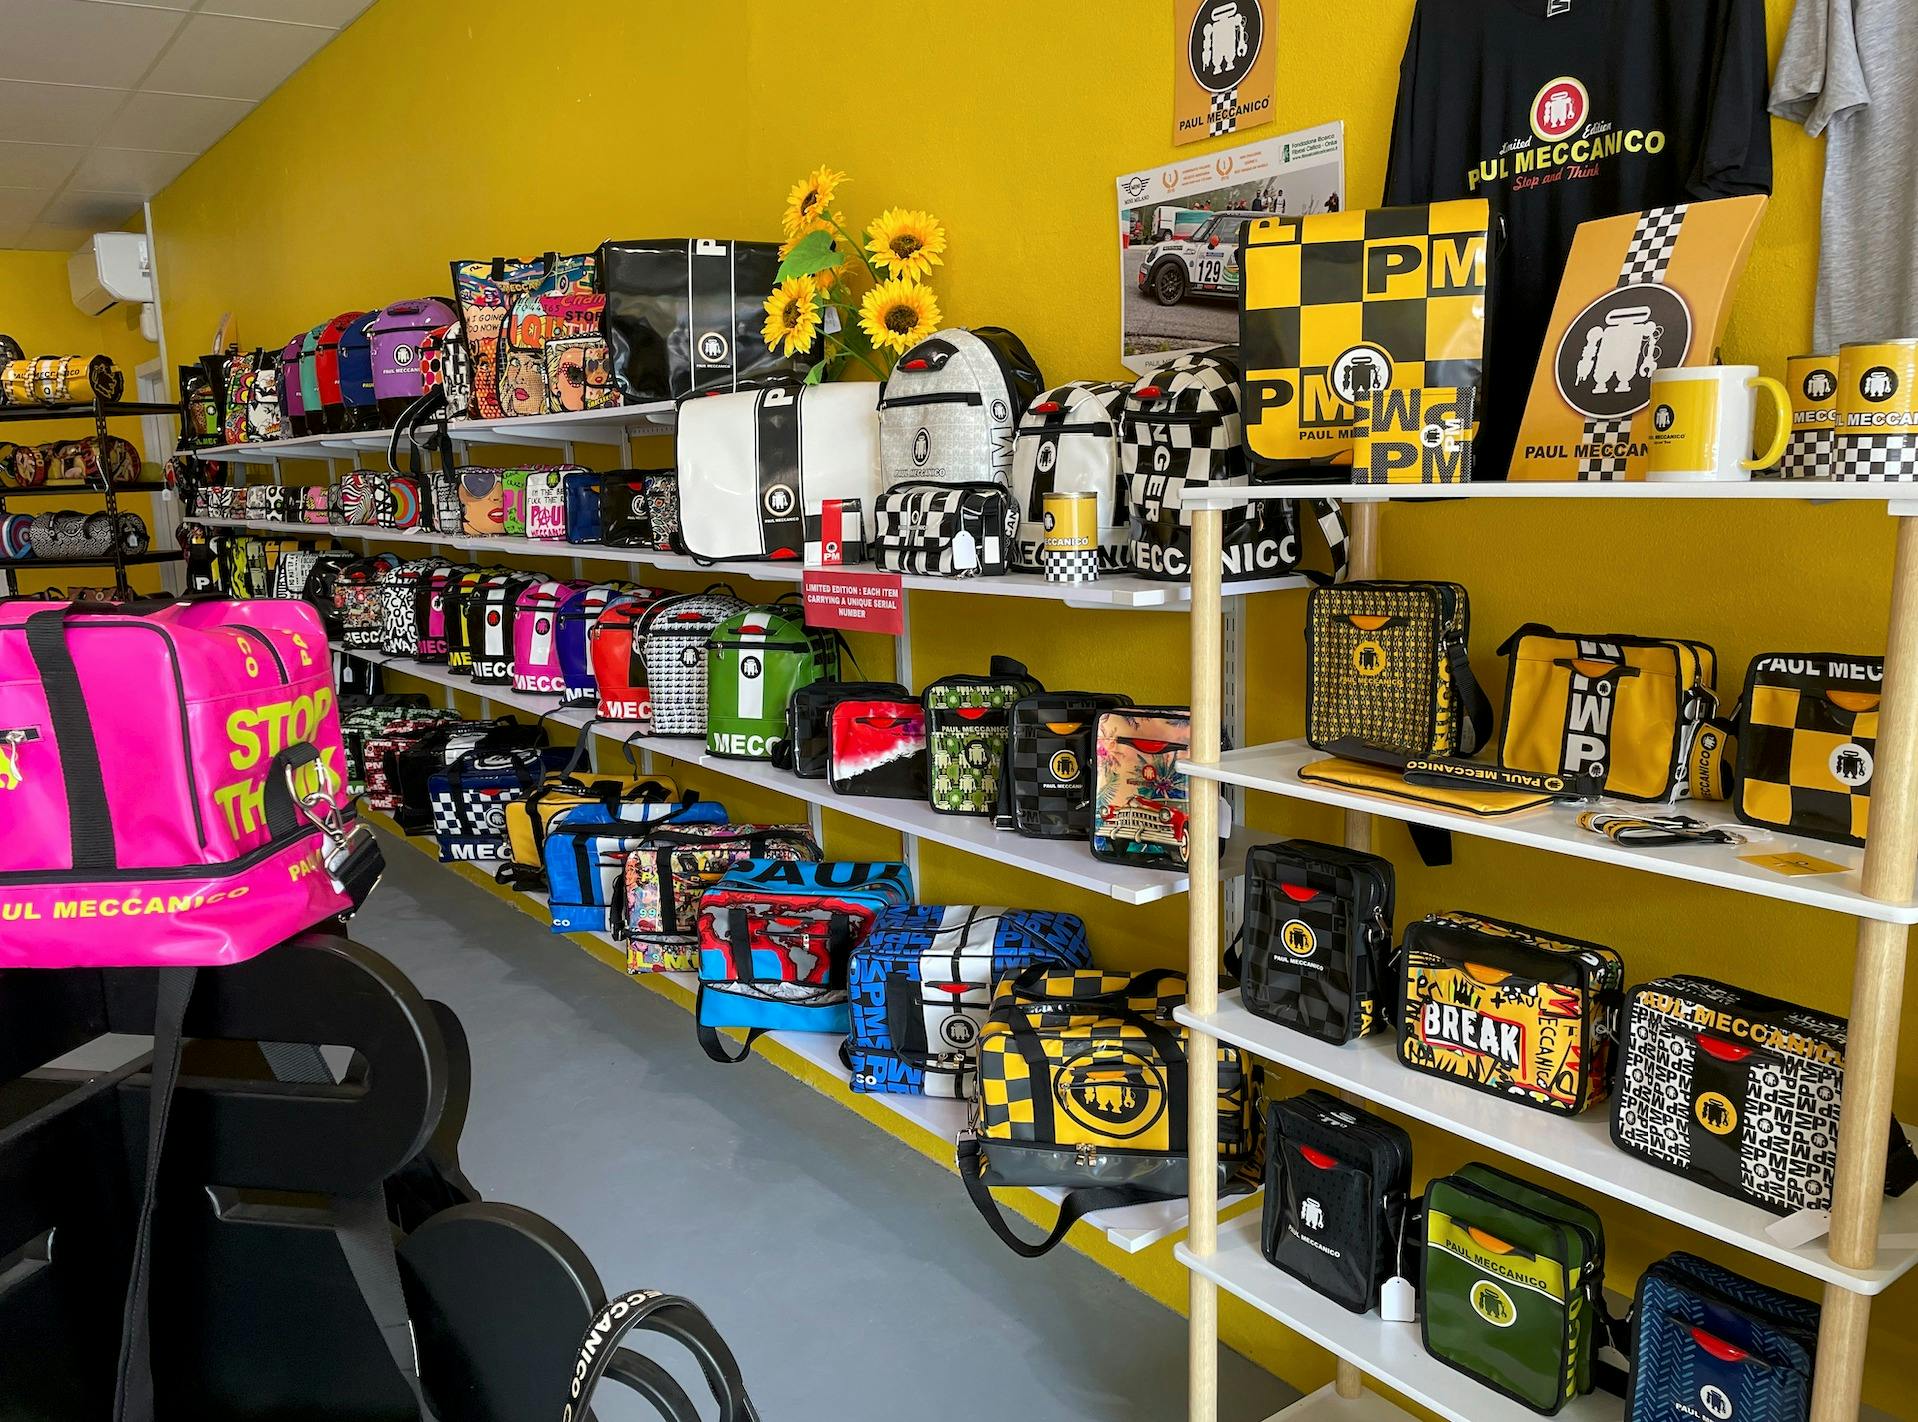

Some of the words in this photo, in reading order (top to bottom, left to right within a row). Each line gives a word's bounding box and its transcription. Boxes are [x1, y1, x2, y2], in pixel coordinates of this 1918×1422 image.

[1179, 116, 1204, 131] PAUL
[1206, 98, 1269, 124] MECCANICO
[1582, 121, 1613, 139] Edition
[1515, 129, 1666, 175] MECCANICO
[1512, 174, 1545, 192] Stop
[1541, 167, 1562, 184] and
[1566, 163, 1601, 180] Think
[1198, 260, 1221, 283] 129
[1367, 236, 1487, 294] PM
[1299, 429, 1334, 441] PAUL
[1524, 446, 1568, 460] PAUL
[893, 469, 909, 479] PAUL
[909, 467, 946, 479] MECCANICO
[823, 552, 841, 561] PM
[195, 575, 211, 591] P
[805, 583, 831, 594] LIMITED
[831, 584, 858, 595] EDITION
[862, 586, 880, 597] EACH
[881, 587, 899, 598] ITEM
[807, 594, 841, 606] CARRYING
[841, 596, 847, 605] A
[846, 596, 873, 608] UNIQUE
[873, 598, 897, 610] SERIAL
[838, 607, 867, 619] NUMBER
[225, 686, 333, 771] STOP
[941, 725, 961, 733] PAUL
[1406, 760, 1498, 781] MECCANICO
[1043, 782, 1057, 790] PAUL
[1501, 772, 1541, 788] PAUL
[53, 886, 250, 920] MECCANICO
[1273, 953, 1289, 965] PAUL
[1289, 957, 1325, 972] MECCANICO
[1424, 1001, 1521, 1065] BREAK
[1287, 1223, 1301, 1239] PAUL
[1300, 1233, 1341, 1259] MECCANICO
[1445, 1238, 1471, 1260] PAUL
[1474, 1253, 1548, 1290] MECCANICO
[1675, 1402, 1701, 1419] PAUL
